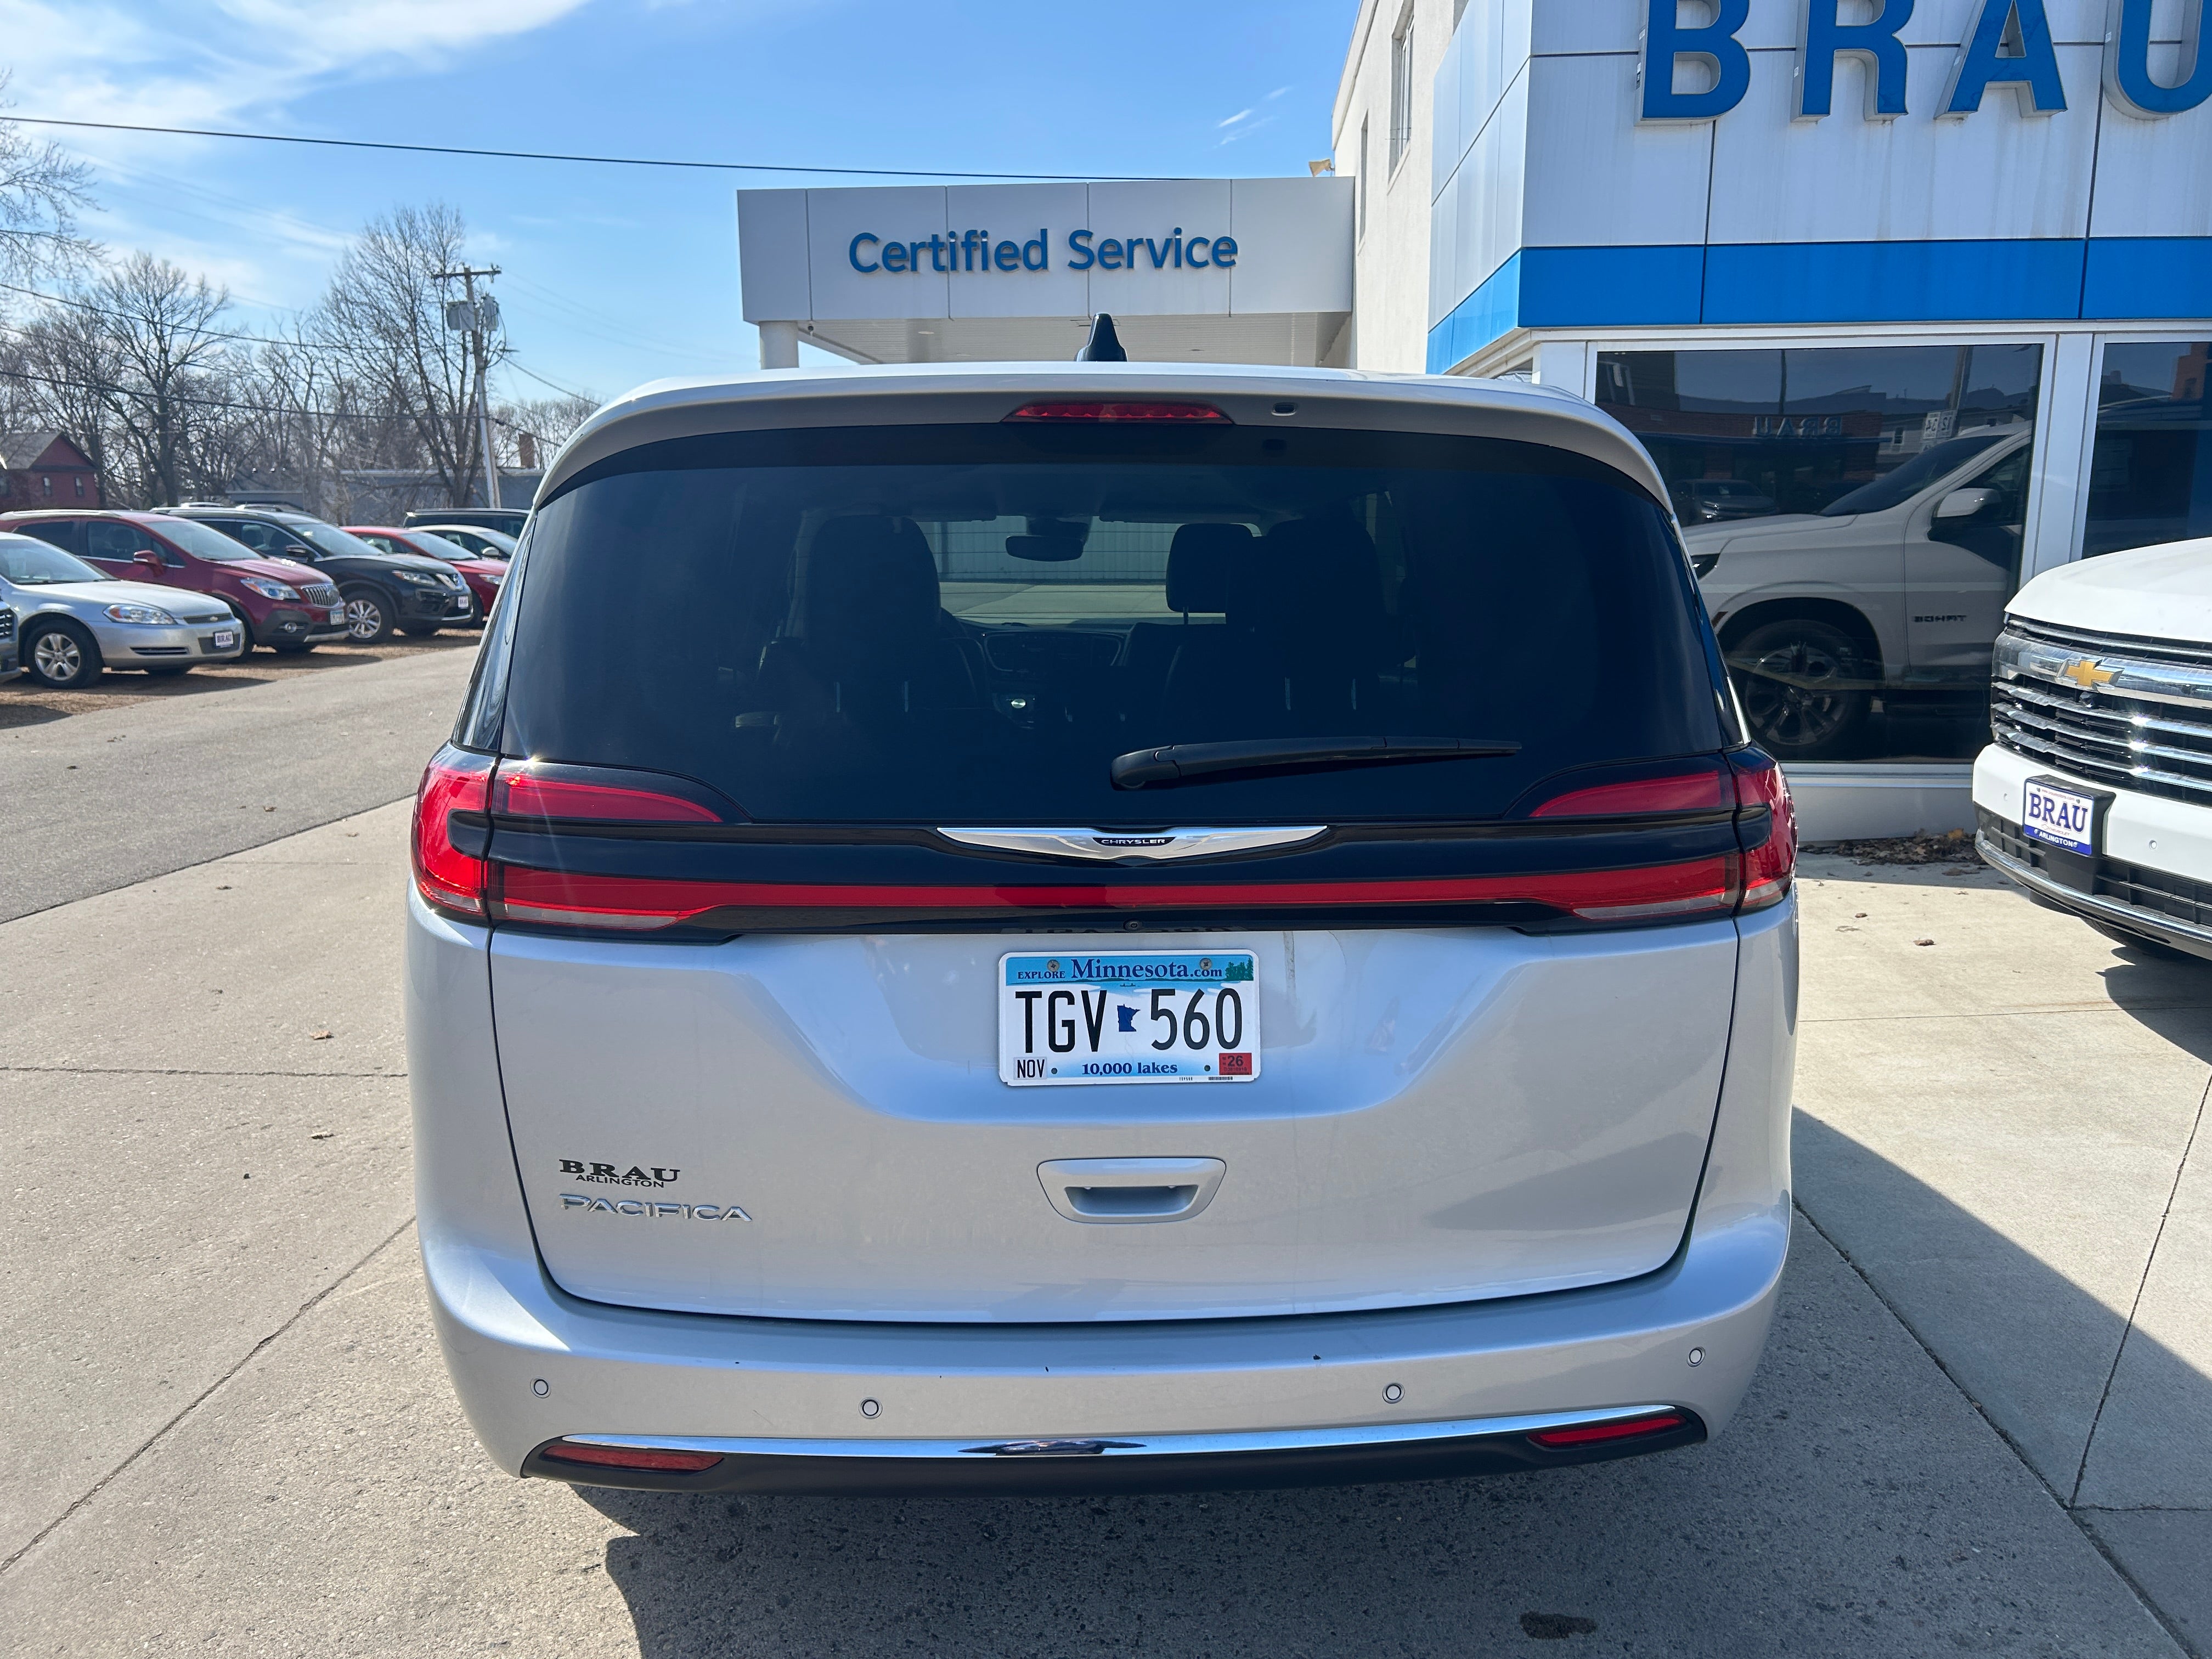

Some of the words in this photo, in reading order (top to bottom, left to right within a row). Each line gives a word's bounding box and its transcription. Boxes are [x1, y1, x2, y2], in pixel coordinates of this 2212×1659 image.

[1637, 0, 2212, 120] BRAU
[849, 228, 1048, 273] Certified
[1068, 227, 1239, 271] Service
[2028, 792, 2088, 833] BRAU
[2039, 831, 2074, 848] ARLINGTON
[1017, 970, 1065, 979] EXPLORE
[1015, 990, 1107, 1053] TGV
[1150, 988, 1243, 1050] 560
[1017, 1059, 1045, 1078] NOV
[1082, 1063, 1132, 1076] 10,000
[1137, 1062, 1178, 1074] lakes
[1228, 1056, 1244, 1067] 26
[559, 1159, 681, 1182] BRAU
[575, 1173, 664, 1188] ARLINGTON
[559, 1193, 753, 1222] PACIFICA
